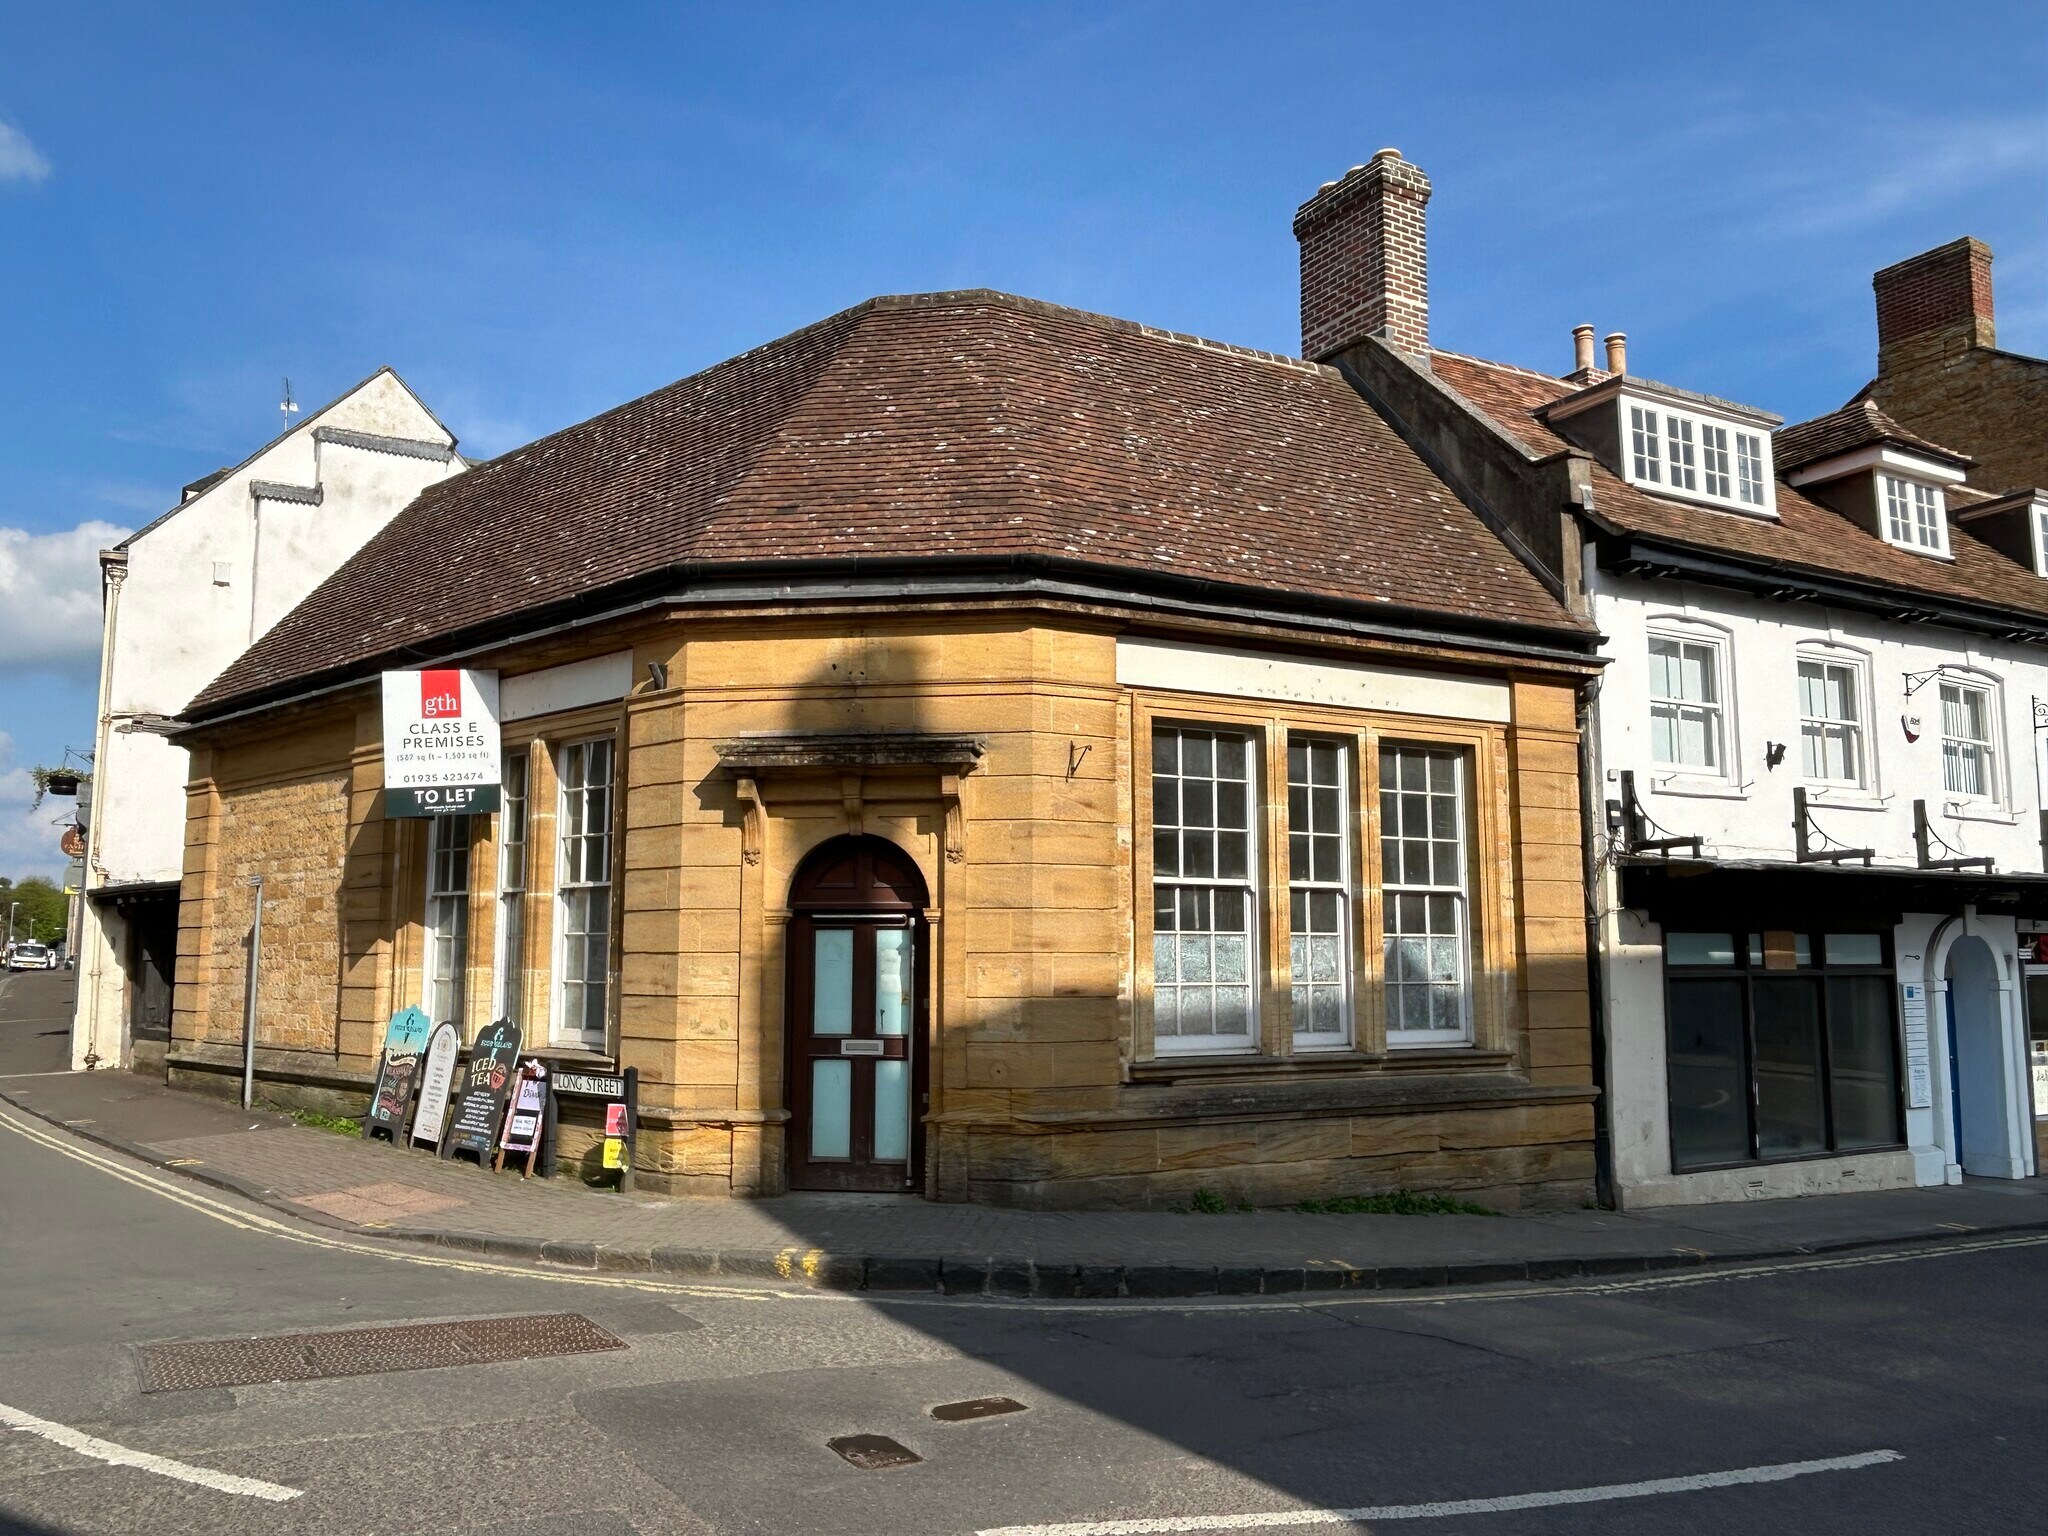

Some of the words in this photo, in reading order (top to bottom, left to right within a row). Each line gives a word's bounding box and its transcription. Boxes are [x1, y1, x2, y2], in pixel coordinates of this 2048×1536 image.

[424, 693, 457, 715] gth
[409, 722, 461, 734] CLASS
[468, 722, 477, 733] E
[403, 735, 484, 748] PREMISES
[403, 774, 438, 783] 01935
[414, 790, 439, 804] TO
[446, 788, 476, 803] LET
[471, 1057, 497, 1073] ICED
[470, 1071, 491, 1087] TEA
[558, 1074, 583, 1091] LONG
[586, 1077, 622, 1095] STREET
